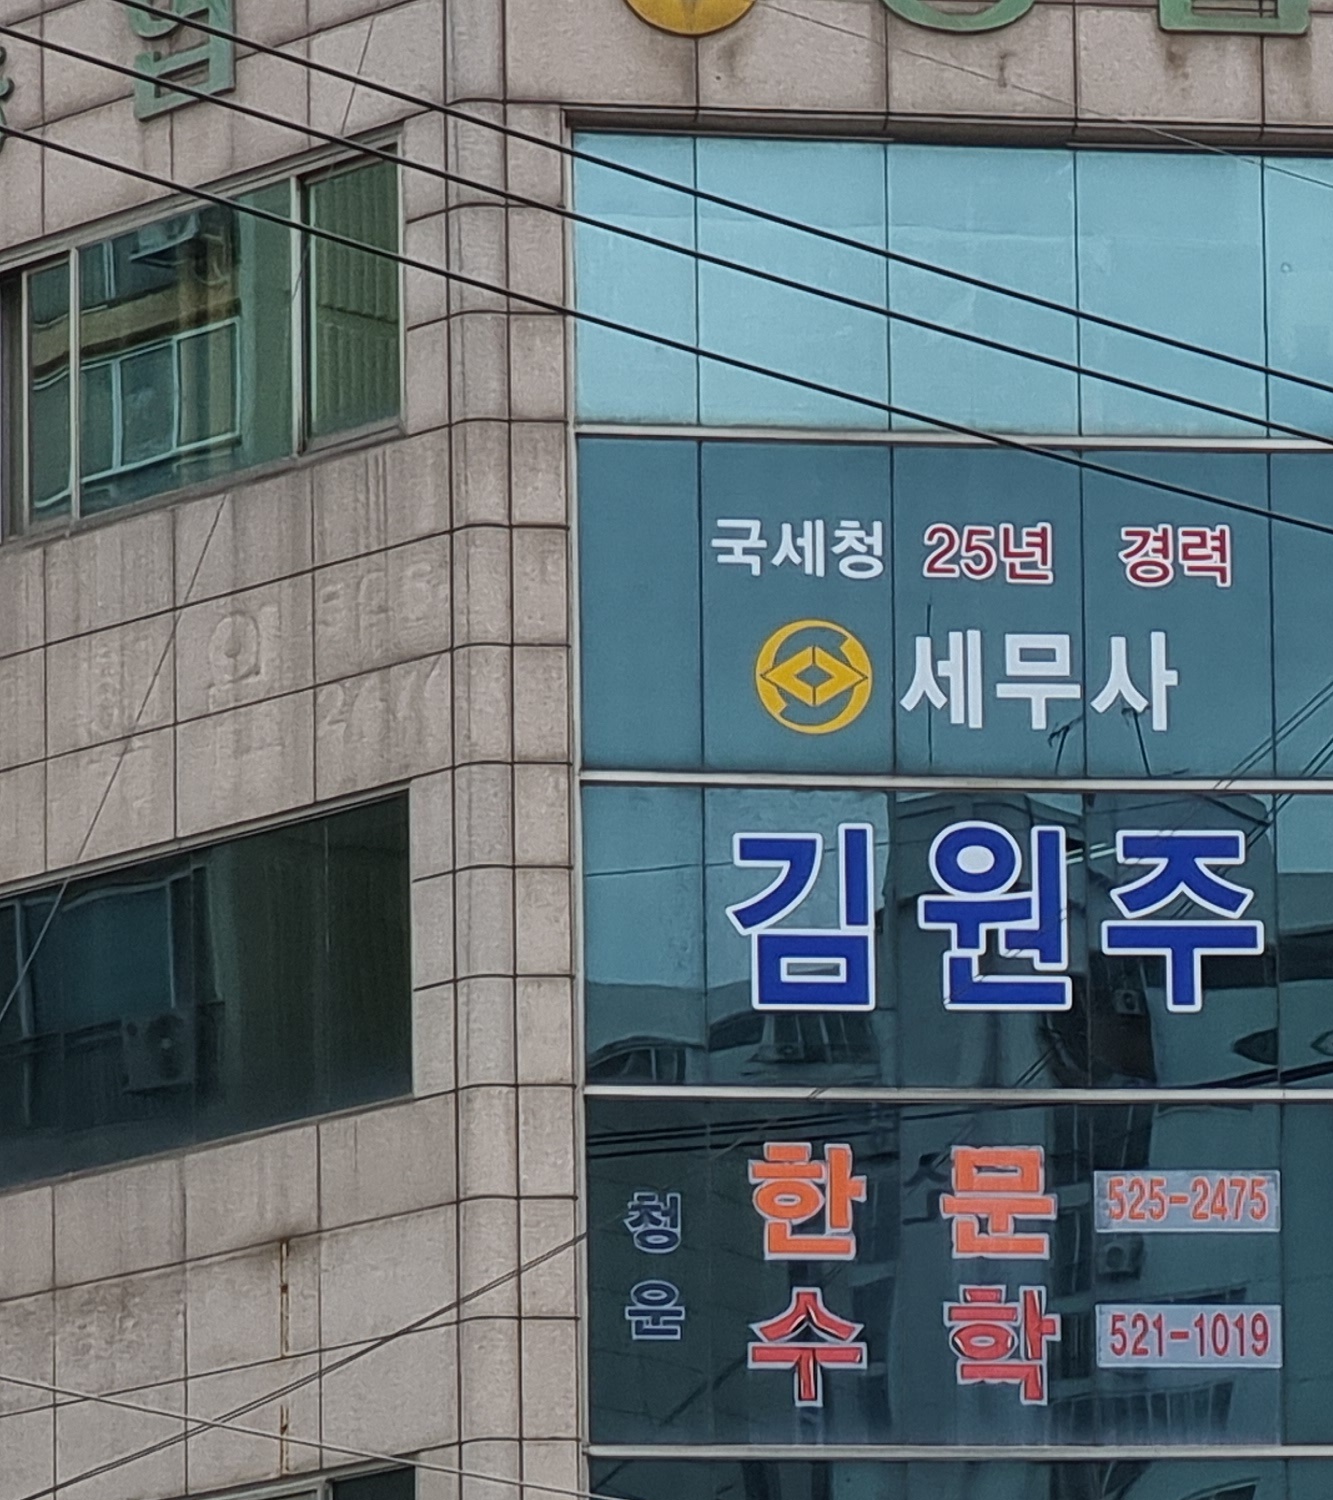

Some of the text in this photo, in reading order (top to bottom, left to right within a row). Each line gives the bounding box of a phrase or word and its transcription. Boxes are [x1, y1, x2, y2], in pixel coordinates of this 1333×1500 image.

[710, 518, 1233, 587] 국세청 25년 경력
[899, 628, 1179, 731] 세무사
[725, 819, 1265, 1012] 김원주
[747, 1142, 1270, 1261] 한문 525-2475
[623, 1190, 686, 1341] 청운
[747, 1285, 1272, 1408] 수학 521-1019
